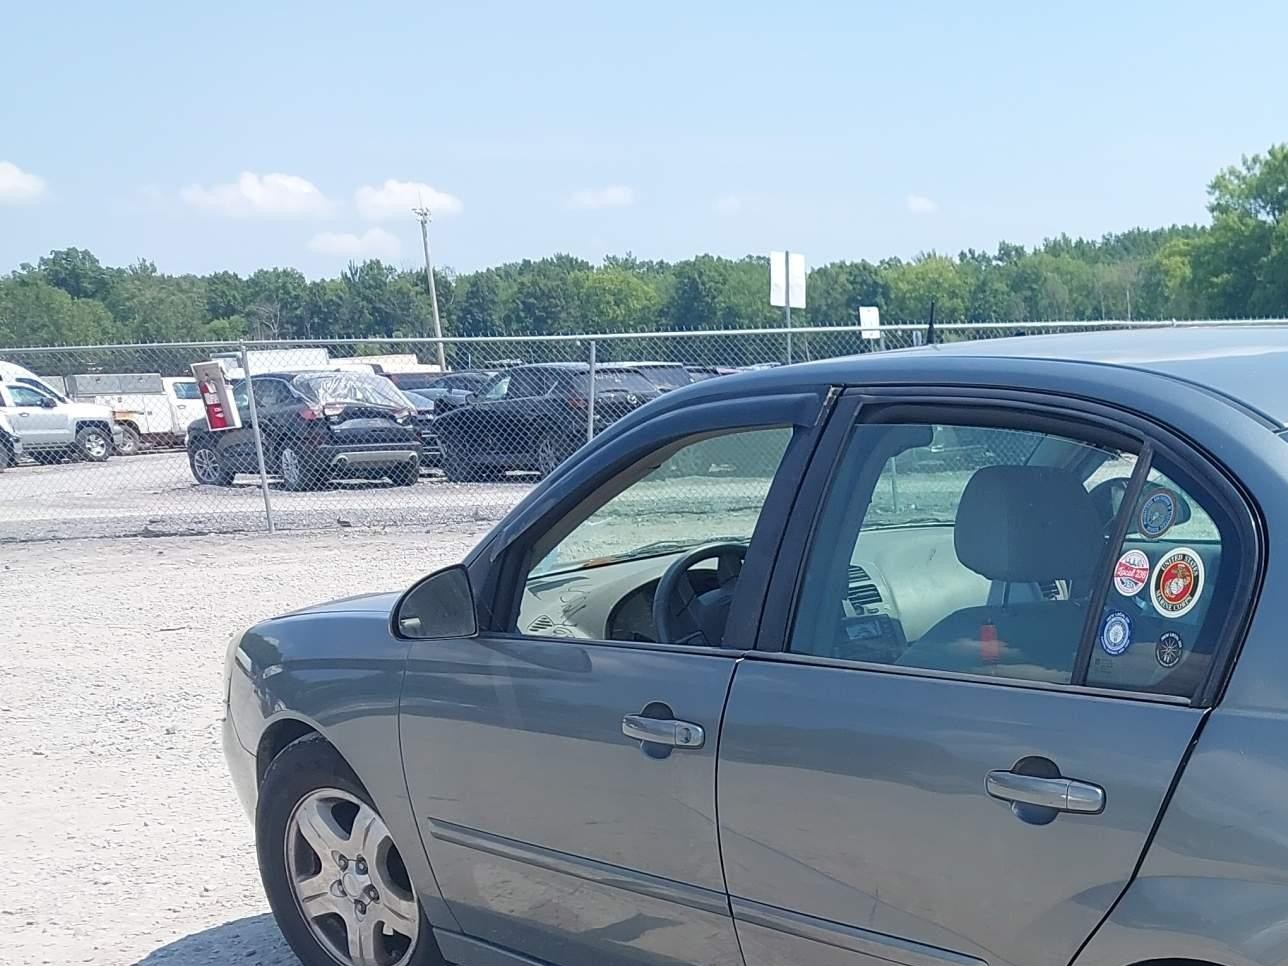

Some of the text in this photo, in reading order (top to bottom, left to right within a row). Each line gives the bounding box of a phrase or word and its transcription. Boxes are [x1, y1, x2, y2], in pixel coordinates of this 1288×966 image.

[1161, 554, 1183, 571] UNITED
[1156, 589, 1193, 611] MARINE CORPS
